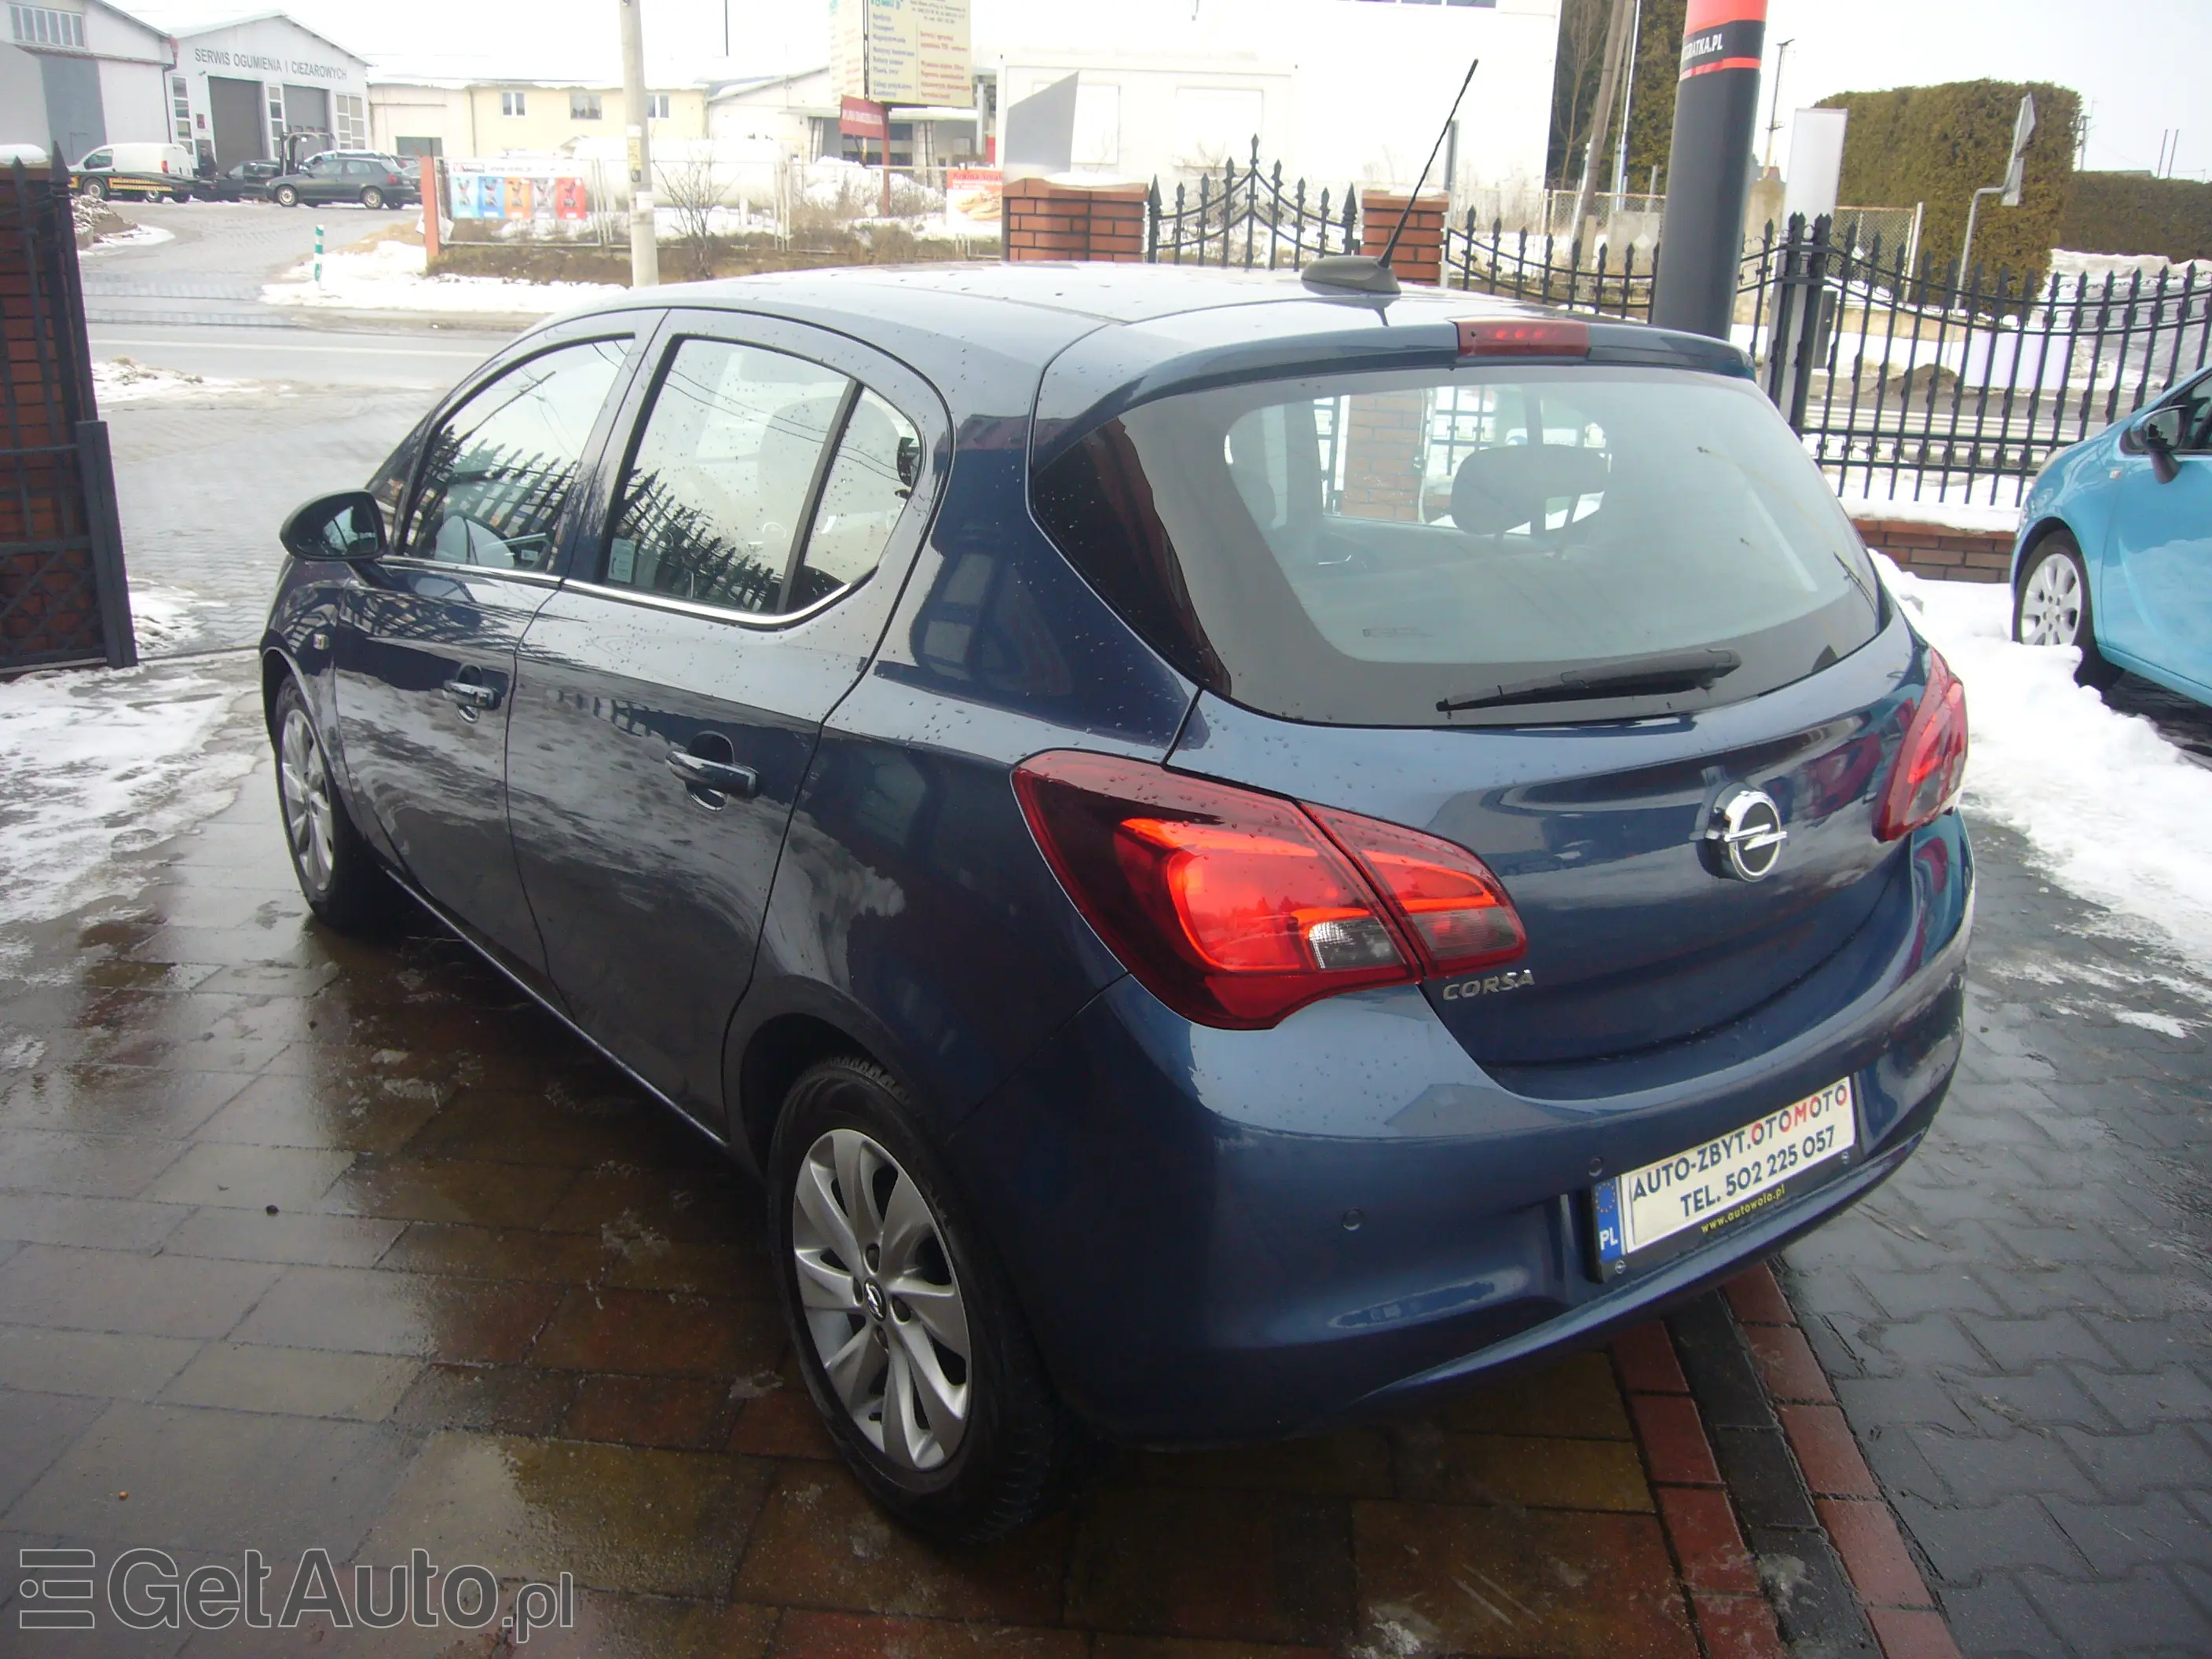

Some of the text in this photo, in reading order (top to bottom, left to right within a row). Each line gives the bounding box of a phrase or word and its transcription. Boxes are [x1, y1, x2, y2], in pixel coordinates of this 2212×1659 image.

[195, 48, 230, 66] SERWIS
[233, 53, 282, 72] OGUMIENIA
[285, 61, 288, 72] I
[1442, 969, 1535, 1001] CORSA
[1679, 1183, 1721, 1218] TEL.
[1726, 1161, 1762, 1199] 502
[1767, 1144, 1798, 1179] 225
[1599, 1226, 1618, 1251] PL
